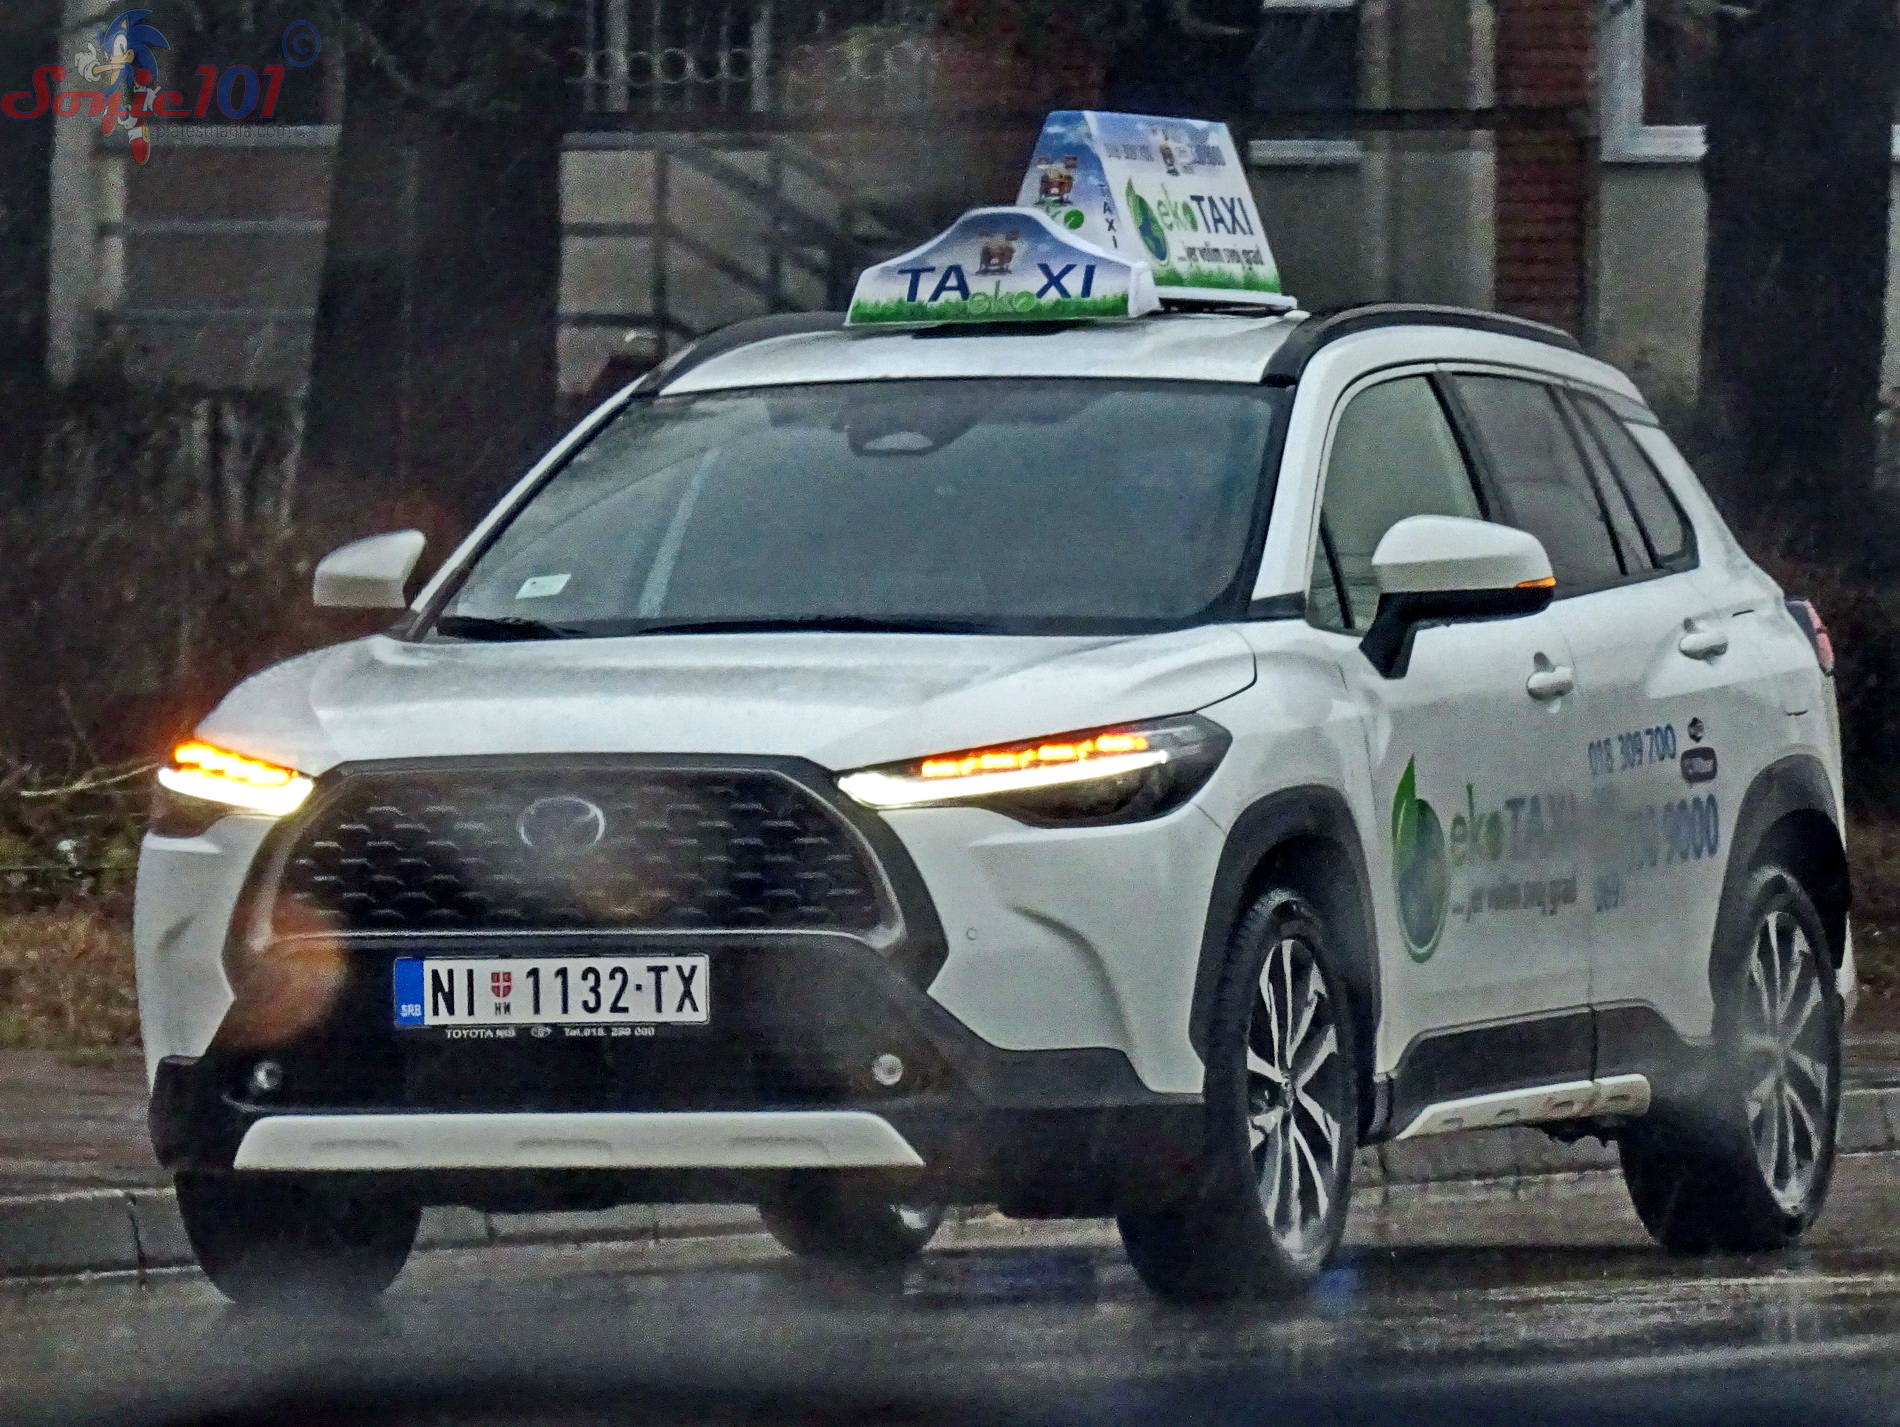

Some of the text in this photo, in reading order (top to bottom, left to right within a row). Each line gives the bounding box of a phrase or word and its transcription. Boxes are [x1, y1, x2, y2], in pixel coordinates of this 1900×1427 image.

[431, 968, 477, 1016] NI
[400, 1003, 422, 1018] SRB
[446, 1029, 493, 1039] TOYOTA
